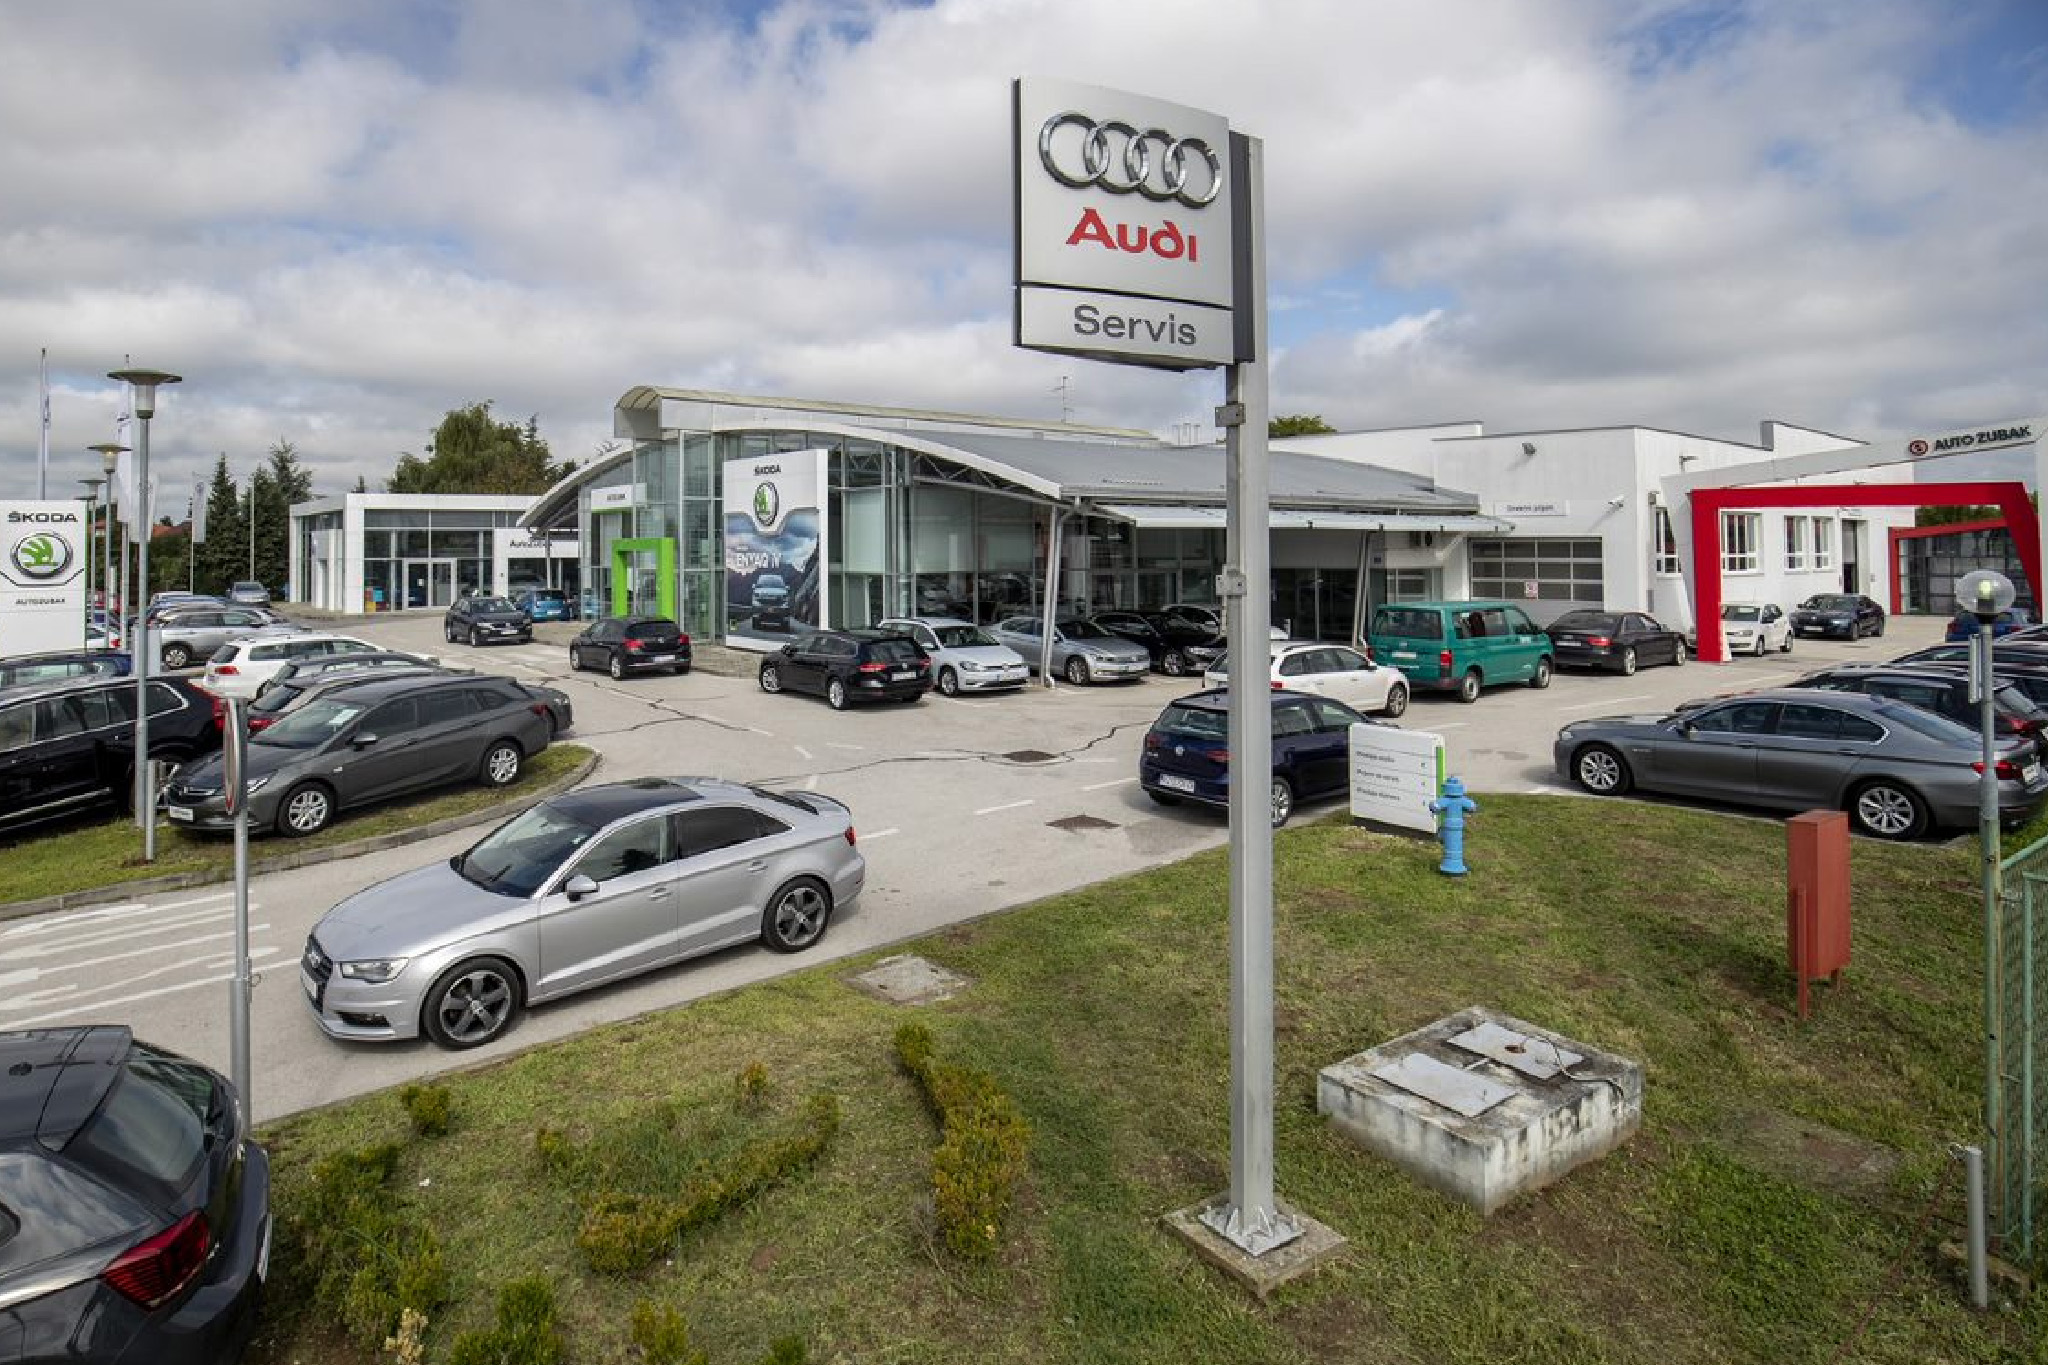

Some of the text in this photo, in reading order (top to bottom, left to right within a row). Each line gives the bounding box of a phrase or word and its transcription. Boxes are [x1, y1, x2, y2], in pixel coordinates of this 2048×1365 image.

[1065, 206, 1198, 263] Audi
[1073, 303, 1198, 345] Servis
[1934, 425, 2032, 451] AUTO ZUBAK
[8, 510, 79, 523] ŠKODA
